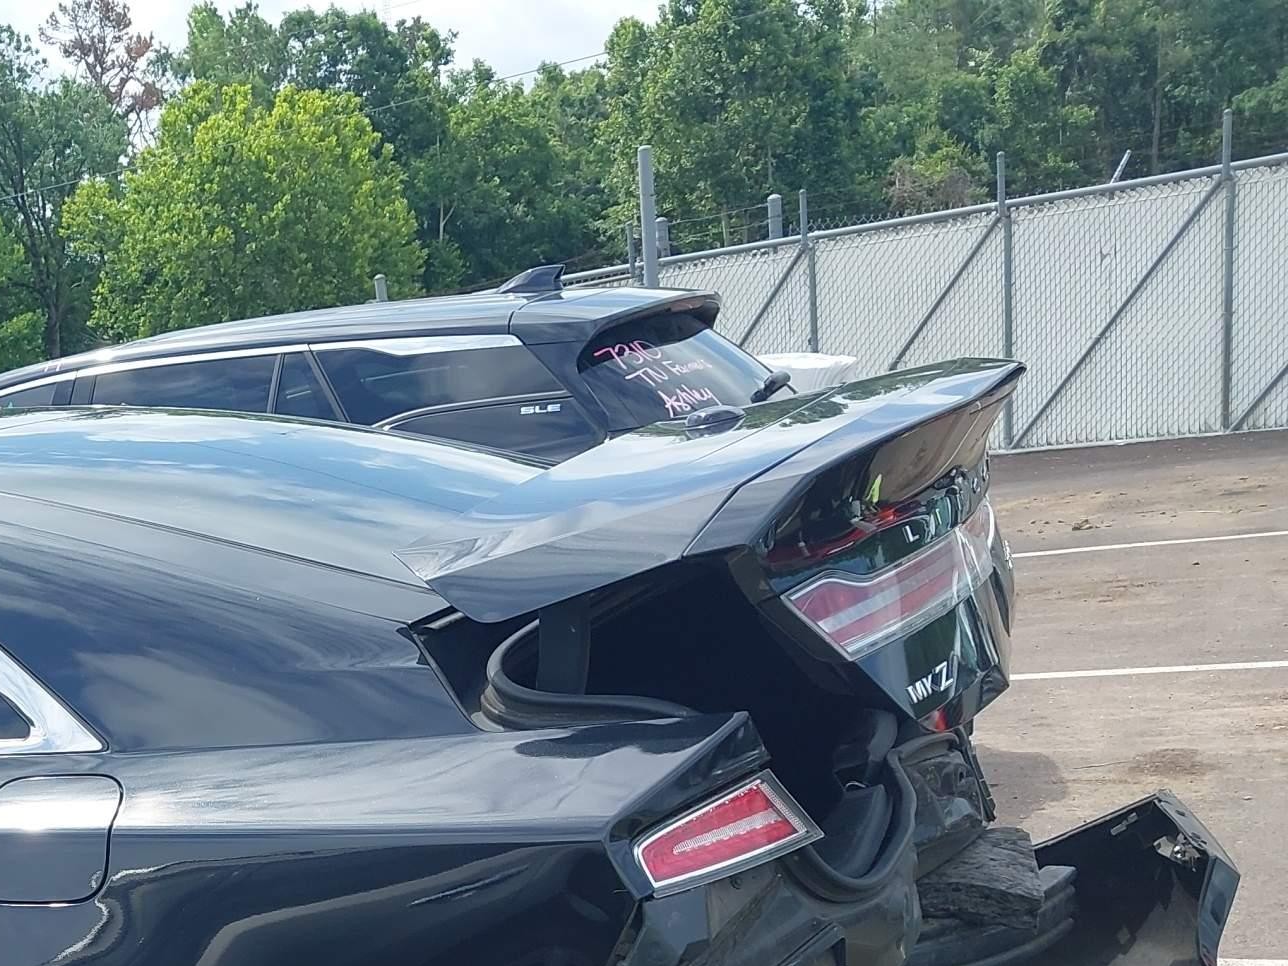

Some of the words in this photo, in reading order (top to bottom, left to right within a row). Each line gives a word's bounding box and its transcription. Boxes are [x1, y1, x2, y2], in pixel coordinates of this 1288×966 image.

[594, 340, 662, 370] 7310
[519, 403, 561, 415] SLE
[904, 660, 954, 704] MKZ
